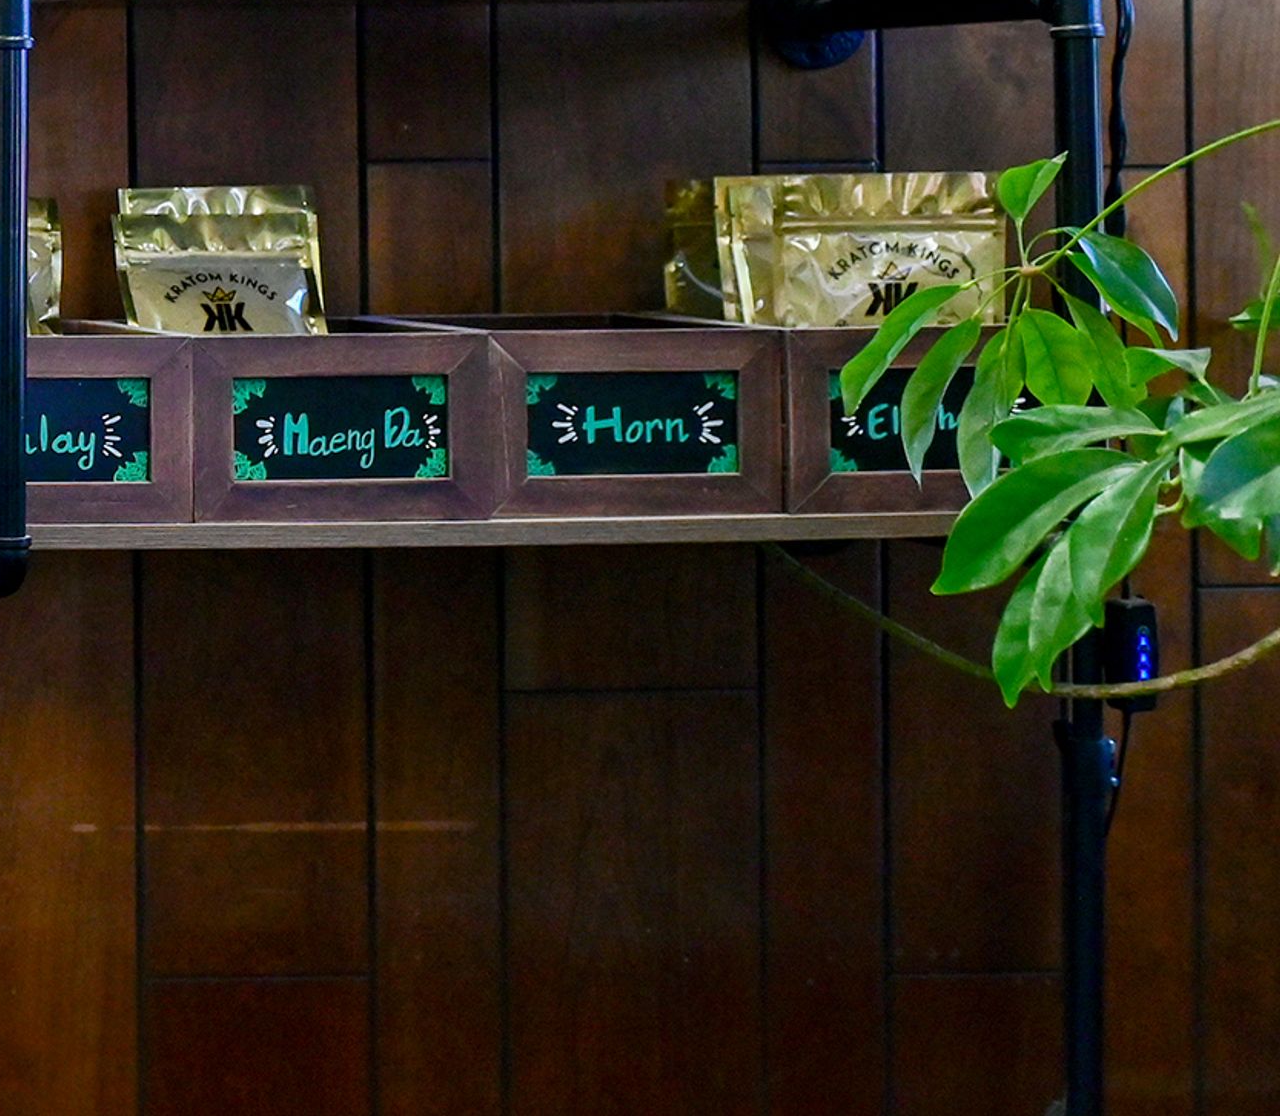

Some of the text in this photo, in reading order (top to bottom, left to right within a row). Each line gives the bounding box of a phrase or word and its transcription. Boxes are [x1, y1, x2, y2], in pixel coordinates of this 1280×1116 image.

[828, 241, 960, 280] KRATOM KINGS
[163, 272, 278, 303] KRATOM KINGS
[282, 405, 425, 469] Maeng Da
[582, 405, 690, 445] Horn
